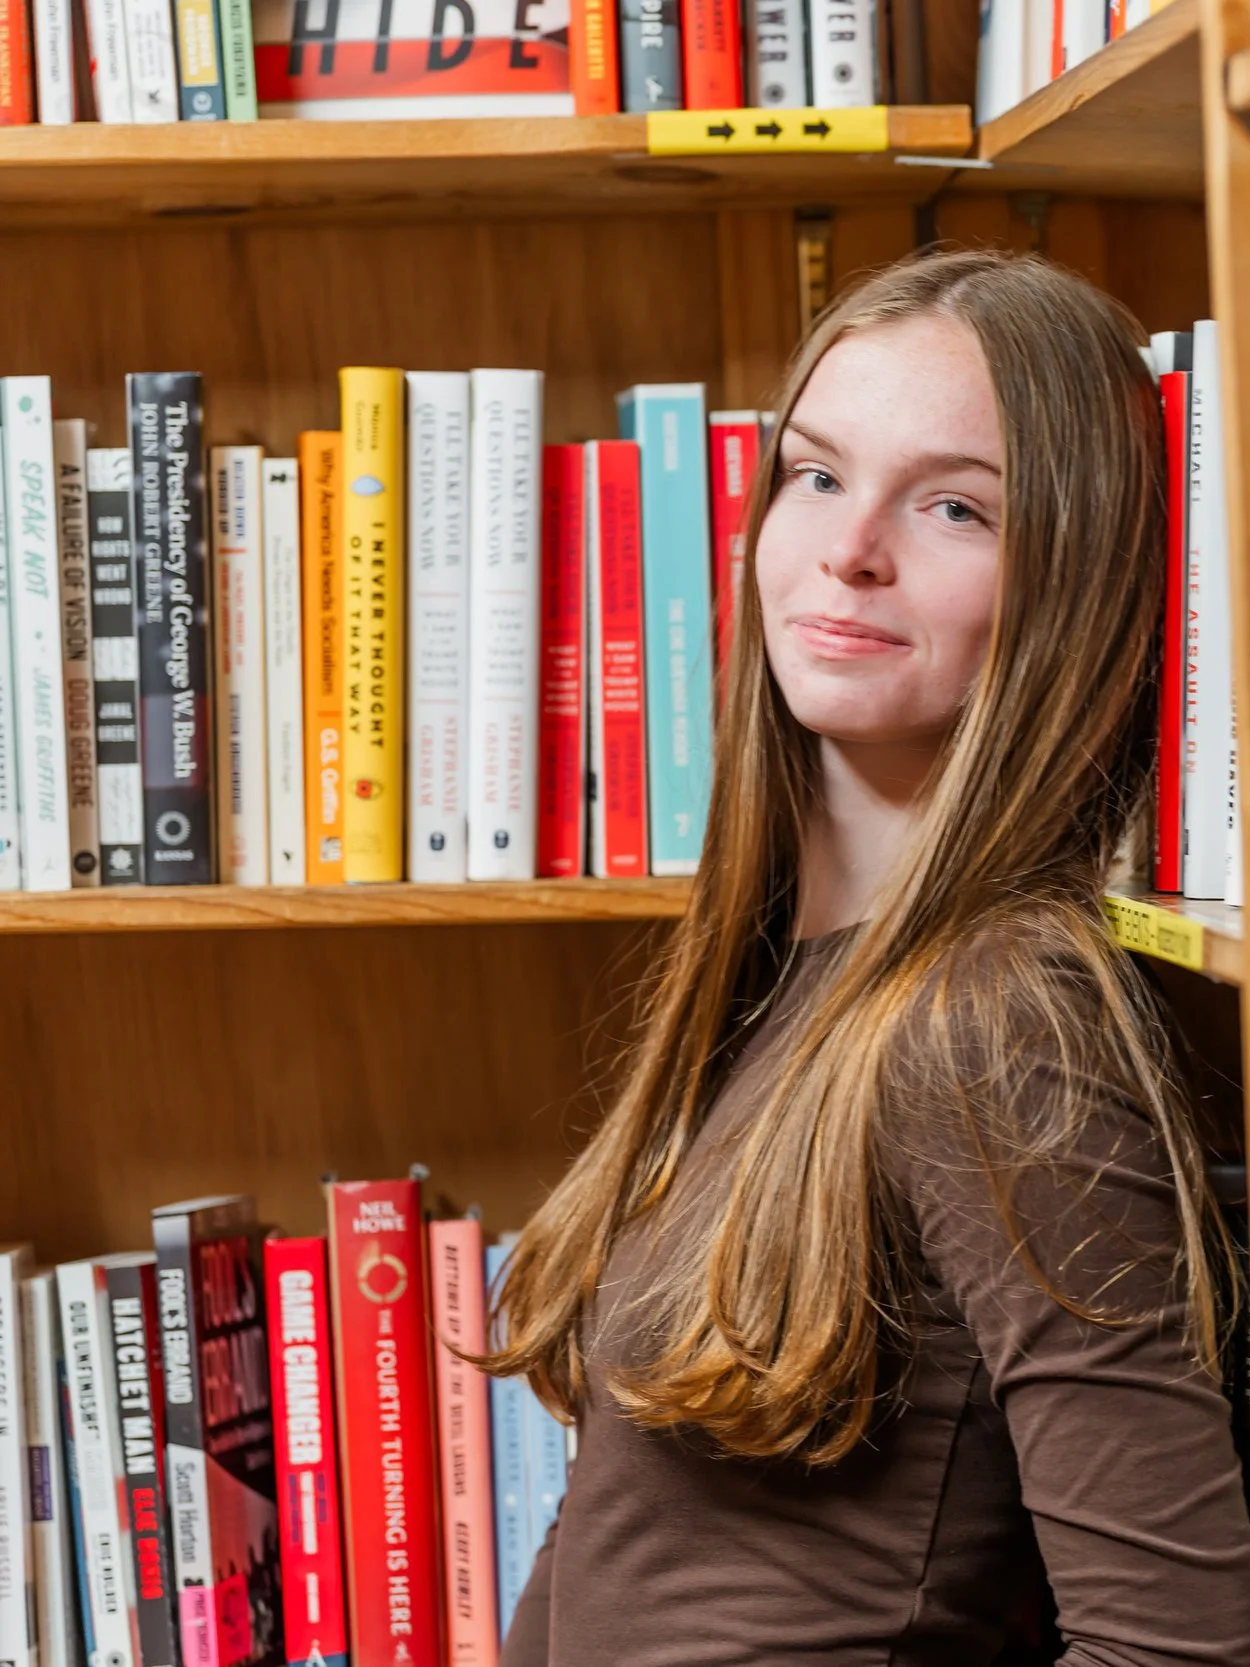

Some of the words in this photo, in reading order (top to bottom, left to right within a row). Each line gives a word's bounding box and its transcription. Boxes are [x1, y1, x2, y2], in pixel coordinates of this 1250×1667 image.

[287, 0, 544, 77] HIDE
[756, 0, 789, 64] WER
[140, 402, 161, 457] JOHN
[164, 401, 189, 448] The
[60, 463, 81, 478] A
[315, 448, 336, 487] Why
[412, 402, 437, 520] QUESTIONS
[445, 456, 463, 502] TAKE
[484, 400, 504, 516] QUESTIONS
[513, 454, 531, 500] TAKE
[19, 459, 47, 542] SPEAK
[62, 484, 86, 562] FAILURE
[143, 460, 162, 539] ROBERT
[164, 451, 192, 577] Presidency
[320, 489, 337, 557] America
[350, 535, 364, 565] OF
[420, 526, 437, 572] NOW
[444, 512, 463, 567] YOUR
[487, 524, 504, 568] NOW
[511, 508, 530, 565] YOUR
[22, 549, 49, 599] NOT
[64, 567, 85, 593] OF
[144, 542, 164, 624] GREENE
[169, 578, 194, 605] of
[320, 561, 338, 612] Needs
[350, 576, 363, 598] IT
[371, 539, 387, 619] NEVER
[1188, 547, 1201, 596] THE
[64, 597, 89, 661] VISION
[164, 606, 194, 689] George
[321, 616, 339, 697] Socialism
[350, 610, 364, 671] THAT
[32, 667, 53, 729] JAMES
[371, 632, 386, 750] THOUGHT
[1186, 608, 1202, 729] ASSAULT
[68, 679, 92, 731] DOUG
[171, 690, 195, 719] W.
[349, 683, 363, 736] WAY
[71, 737, 96, 809] GREENE
[172, 721, 197, 778] Bush
[351, 1213, 407, 1235] HOWE
[358, 1200, 398, 1218] NEIL
[70, 1300, 90, 1337] OUR
[277, 1269, 317, 1344] GAME
[111, 1297, 151, 1411] HATCHET
[162, 1329, 194, 1405] ERRAND
[282, 1344, 324, 1467] CHANGER
[374, 1339, 402, 1433] FOURTH
[122, 1414, 156, 1475] MAN
[541, 1415, 558, 1483] JORITY
[174, 1461, 197, 1504] Scott
[380, 1436, 408, 1545] TURNING
[180, 1508, 201, 1564] Horton
[386, 1549, 410, 1571] IS
[387, 1575, 413, 1638] HERE
